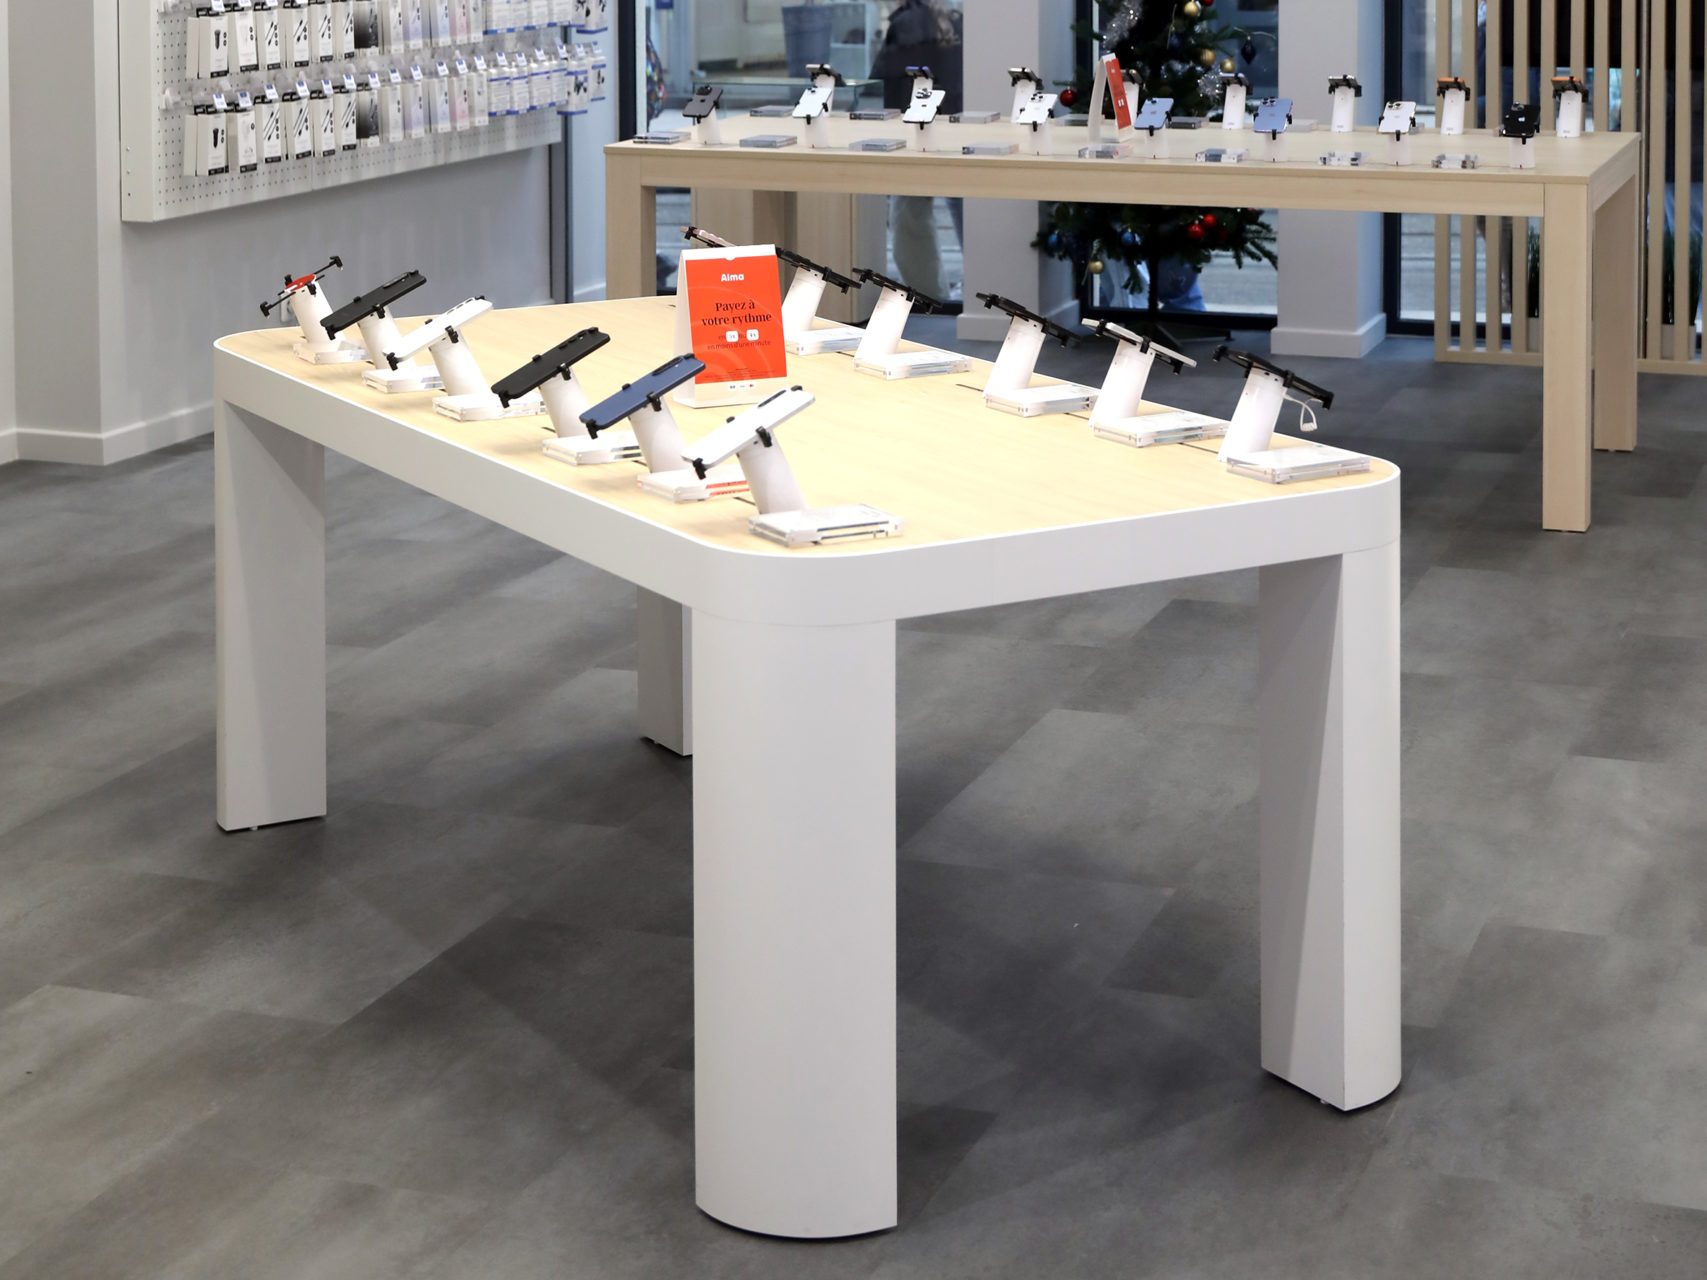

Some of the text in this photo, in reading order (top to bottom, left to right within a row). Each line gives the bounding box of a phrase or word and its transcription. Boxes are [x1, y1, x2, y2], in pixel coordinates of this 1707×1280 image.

[721, 273, 745, 282] Alma
[715, 299, 755, 313] Payez à
[702, 313, 772, 326] votre rythme
